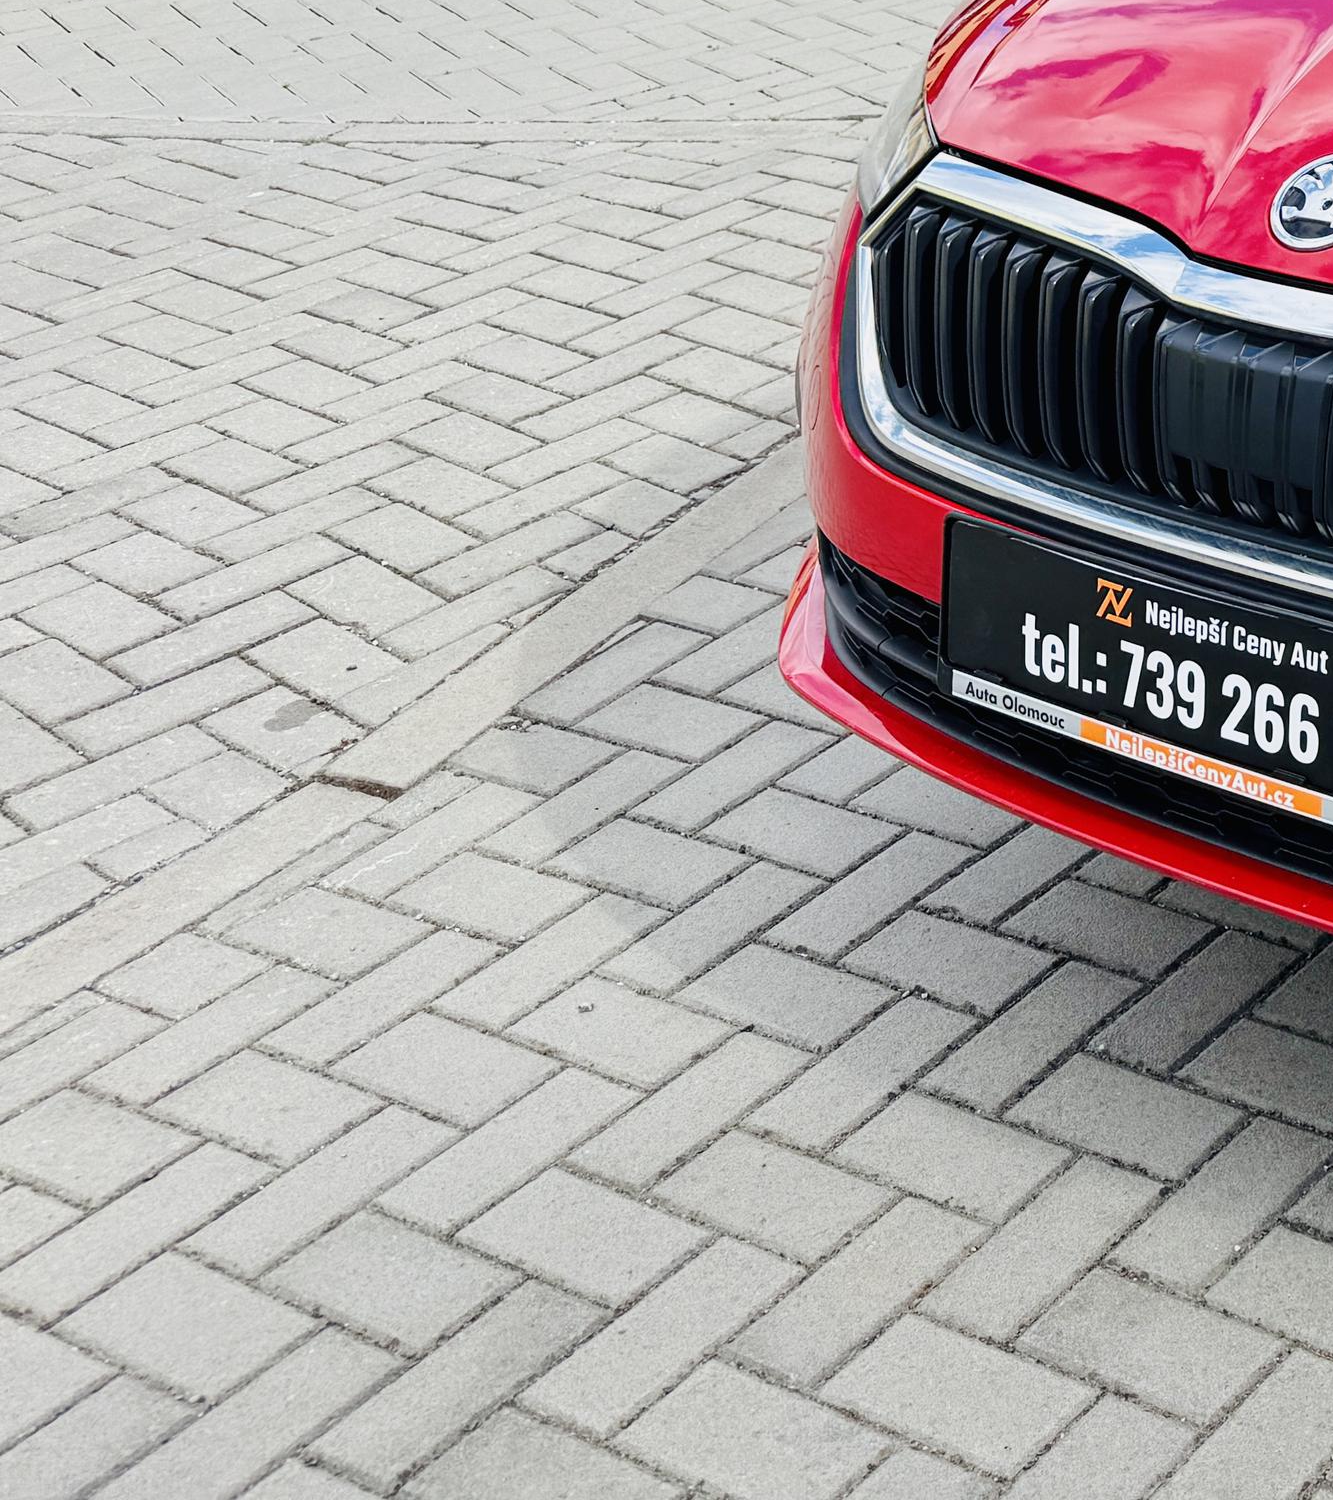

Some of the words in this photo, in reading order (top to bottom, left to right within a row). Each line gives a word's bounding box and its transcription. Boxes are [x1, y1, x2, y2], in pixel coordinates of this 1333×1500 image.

[1145, 599, 1229, 646] Nejlepší
[1233, 625, 1286, 666] Ceny
[1290, 640, 1329, 675] Aut
[964, 681, 998, 706] Auta
[1002, 694, 1065, 730] Olomouc
[1021, 612, 1107, 695] tel.:
[1120, 639, 1206, 730] 739
[1220, 673, 1320, 765] 266
